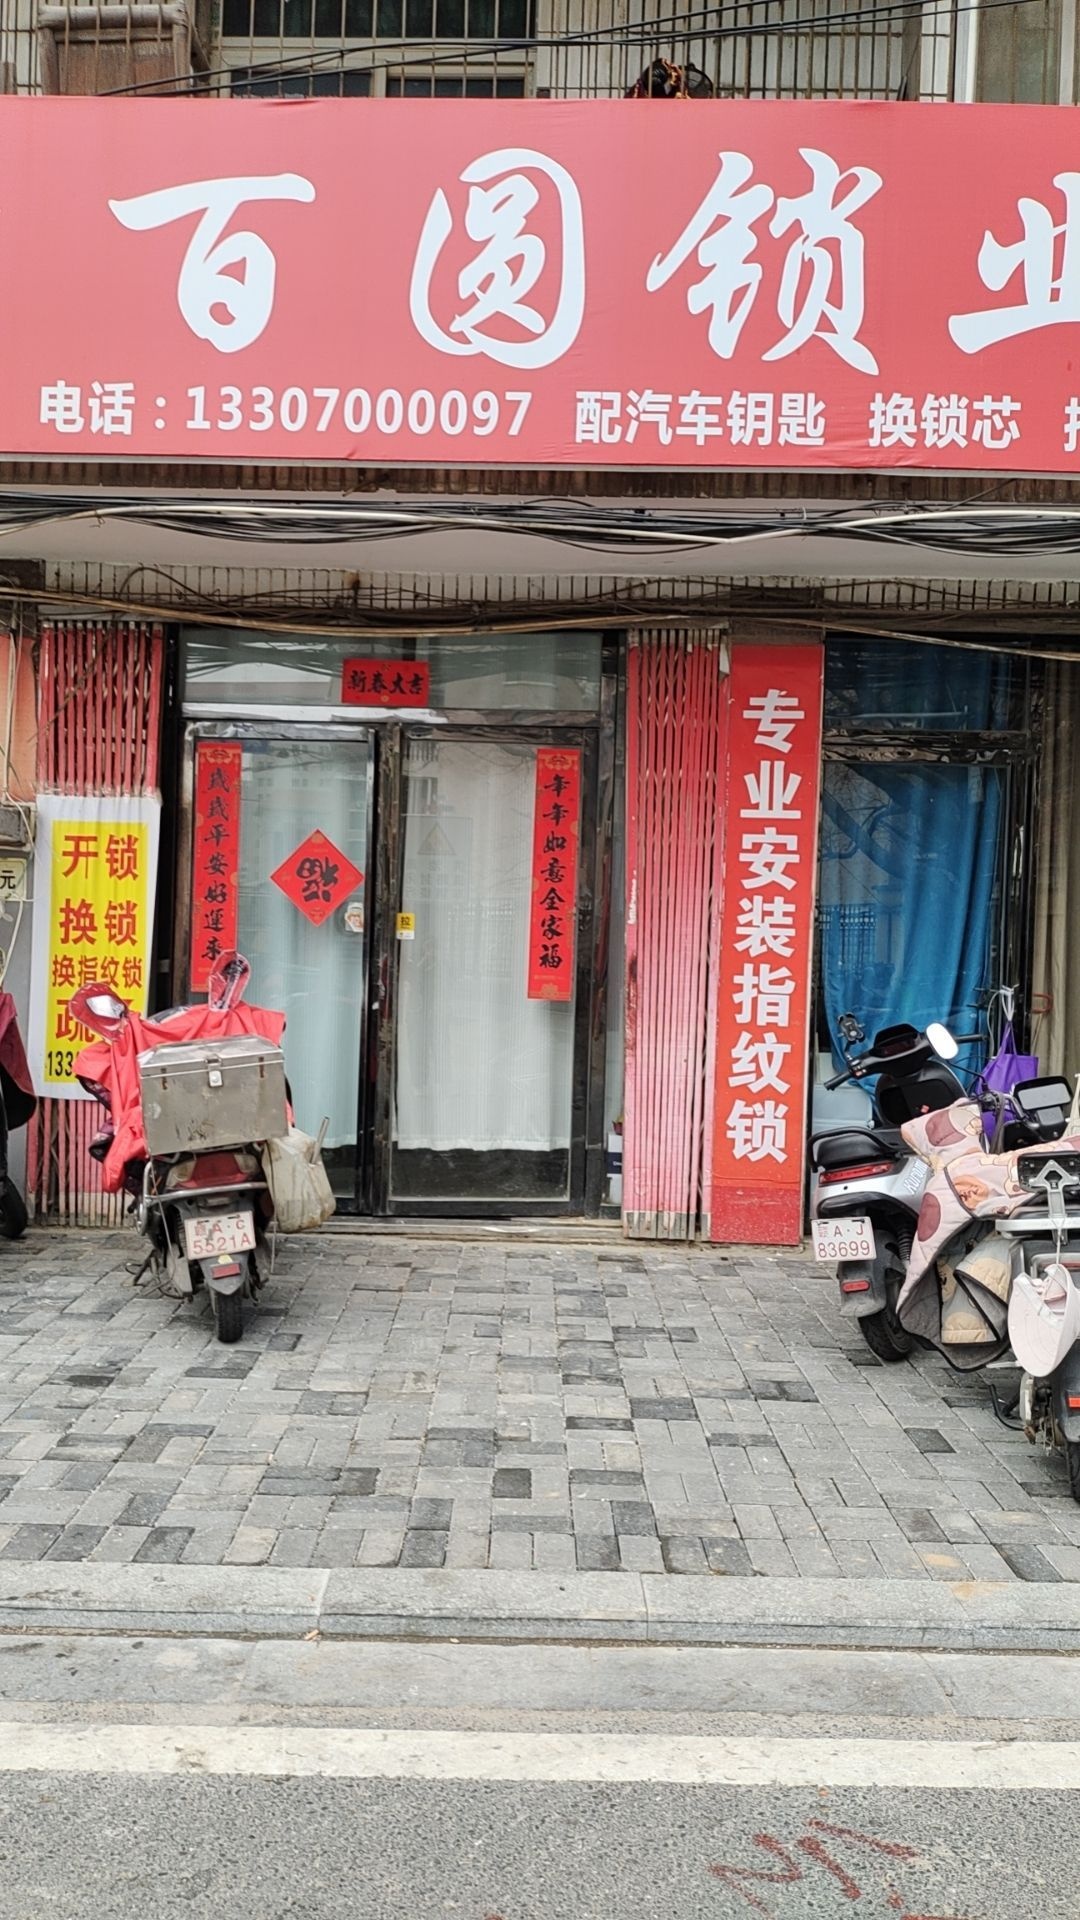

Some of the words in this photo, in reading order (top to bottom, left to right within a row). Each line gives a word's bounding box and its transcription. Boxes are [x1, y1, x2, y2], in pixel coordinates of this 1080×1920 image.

[574, 389, 826, 447] 配汽车钥匙
[868, 392, 1022, 449] 换锁芯
[347, 669, 425, 695] 新春大吉
[62, 833, 139, 881] 开锁
[296, 856, 340, 903] 福
[539, 773, 571, 969] 年年如意全家福
[59, 898, 138, 947] 换锁
[725, 688, 806, 1165] 专业安装指纹锁
[52, 953, 143, 990] 换指纹锁
[817, 1239, 871, 1258] 83699
